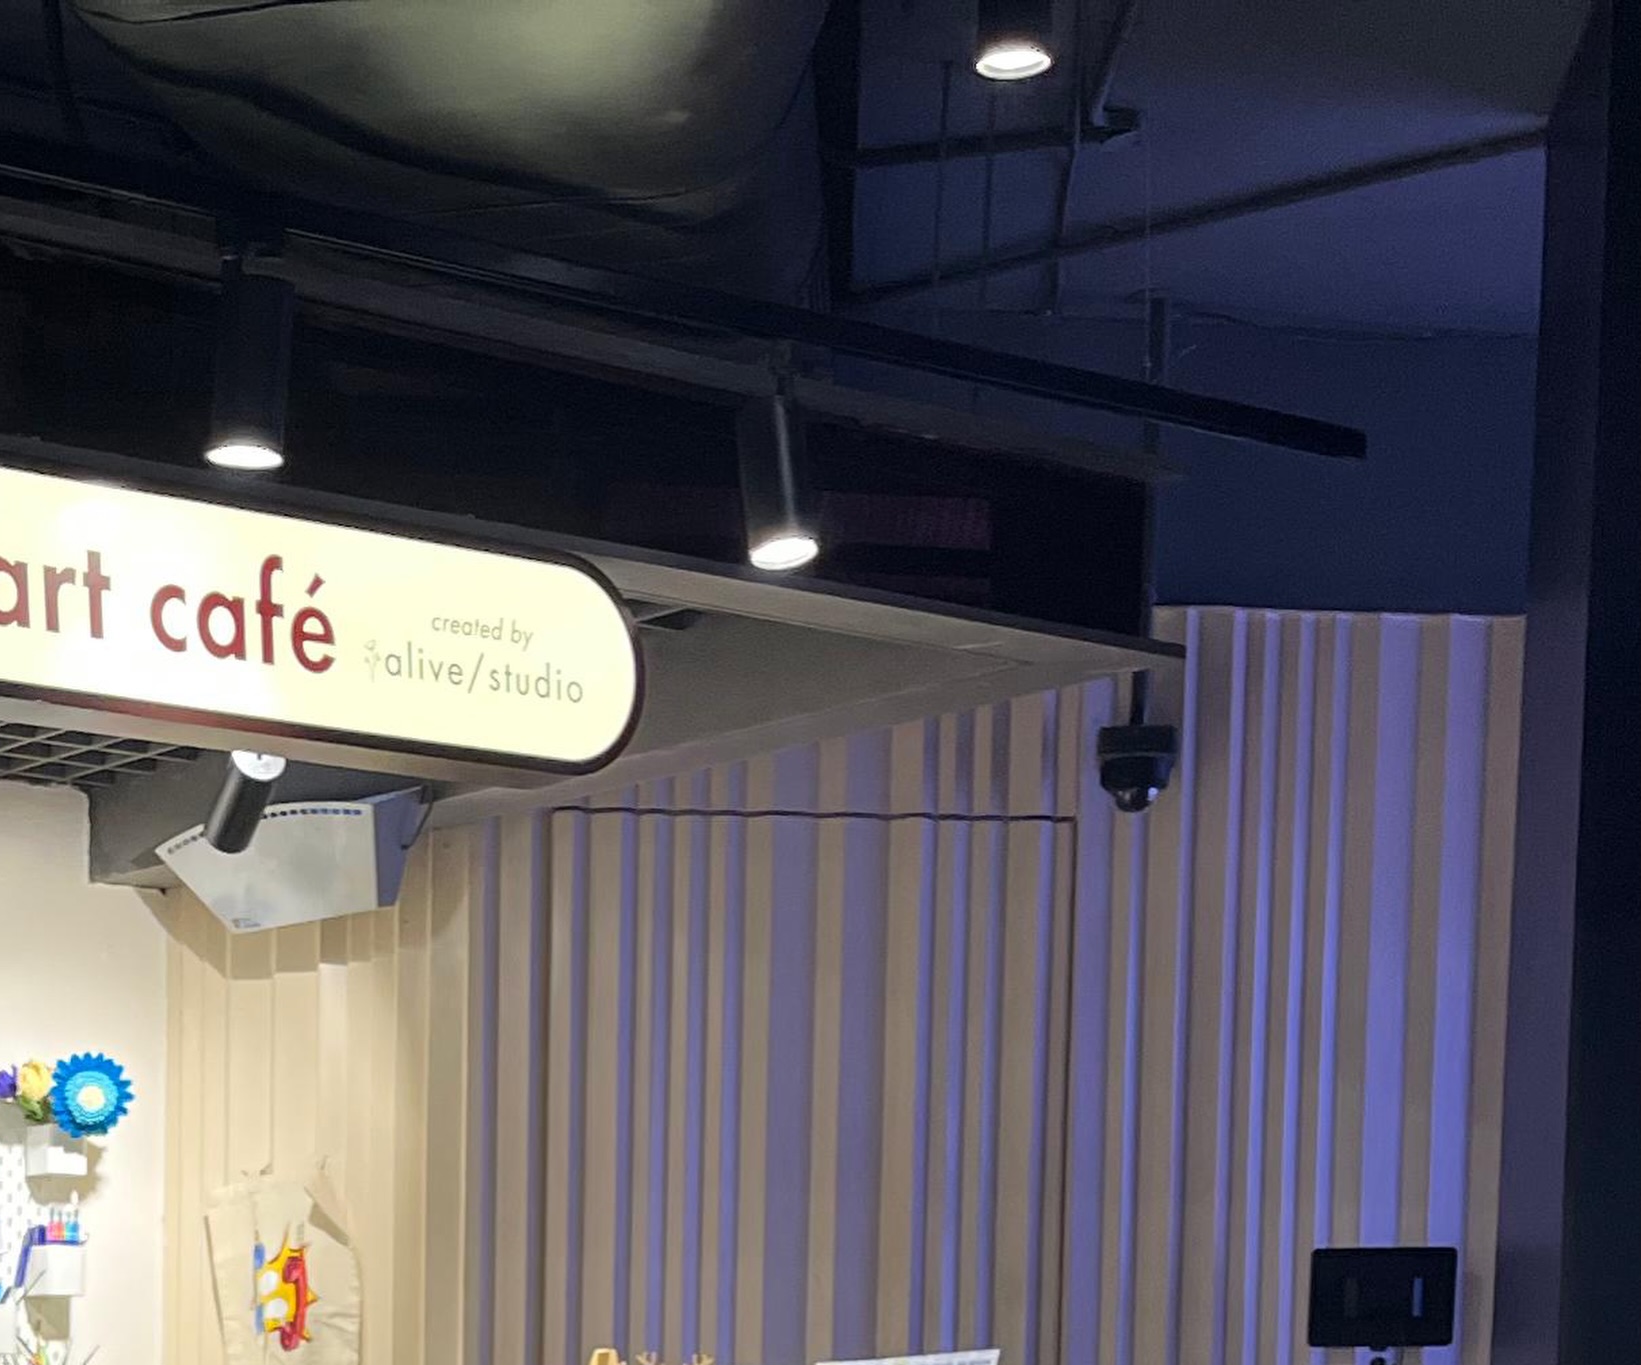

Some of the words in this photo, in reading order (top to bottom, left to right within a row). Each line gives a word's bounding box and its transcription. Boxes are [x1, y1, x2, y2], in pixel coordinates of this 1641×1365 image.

[150, 554, 337, 674] café
[431, 616, 504, 641] created
[510, 618, 534, 652] by
